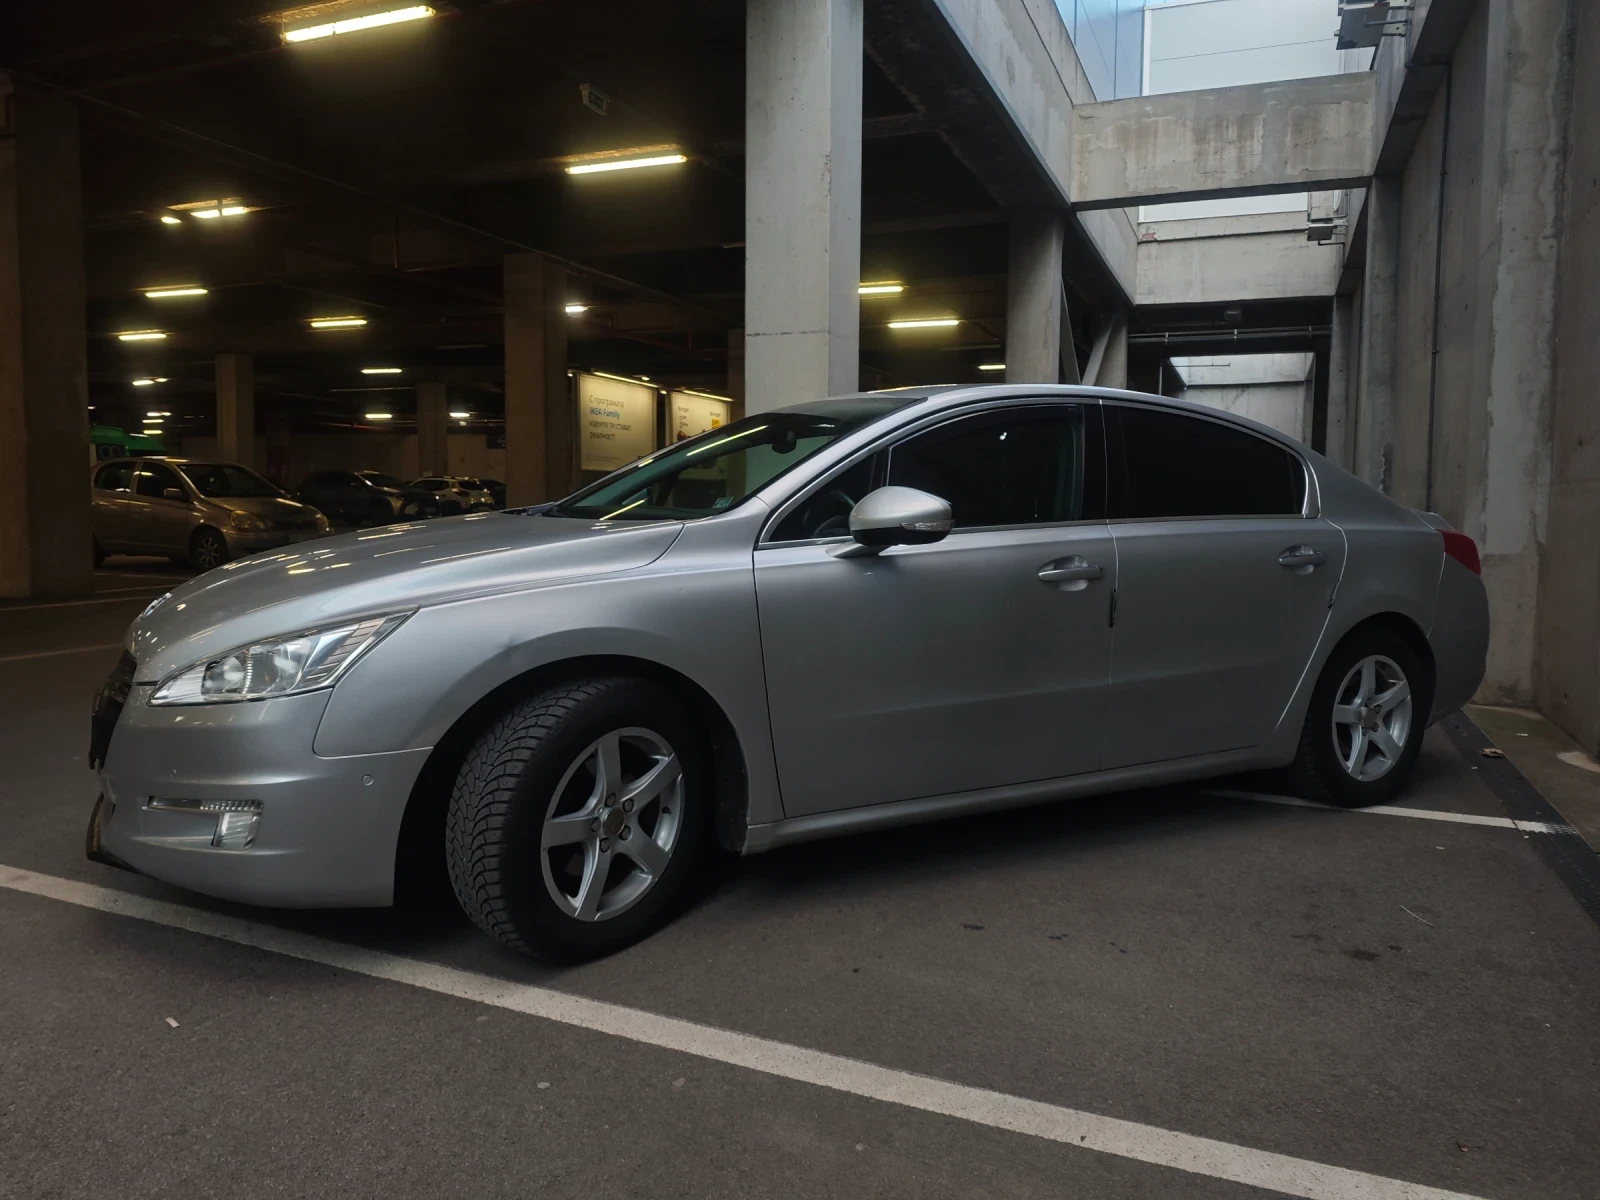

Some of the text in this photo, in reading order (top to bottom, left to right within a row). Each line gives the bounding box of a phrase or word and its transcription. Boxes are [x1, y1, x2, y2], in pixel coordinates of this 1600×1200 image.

[595, 397, 625, 408] програмата
[590, 407, 621, 420] IKEA Family
[590, 420, 608, 429] идеите
[616, 423, 632, 431] стават
